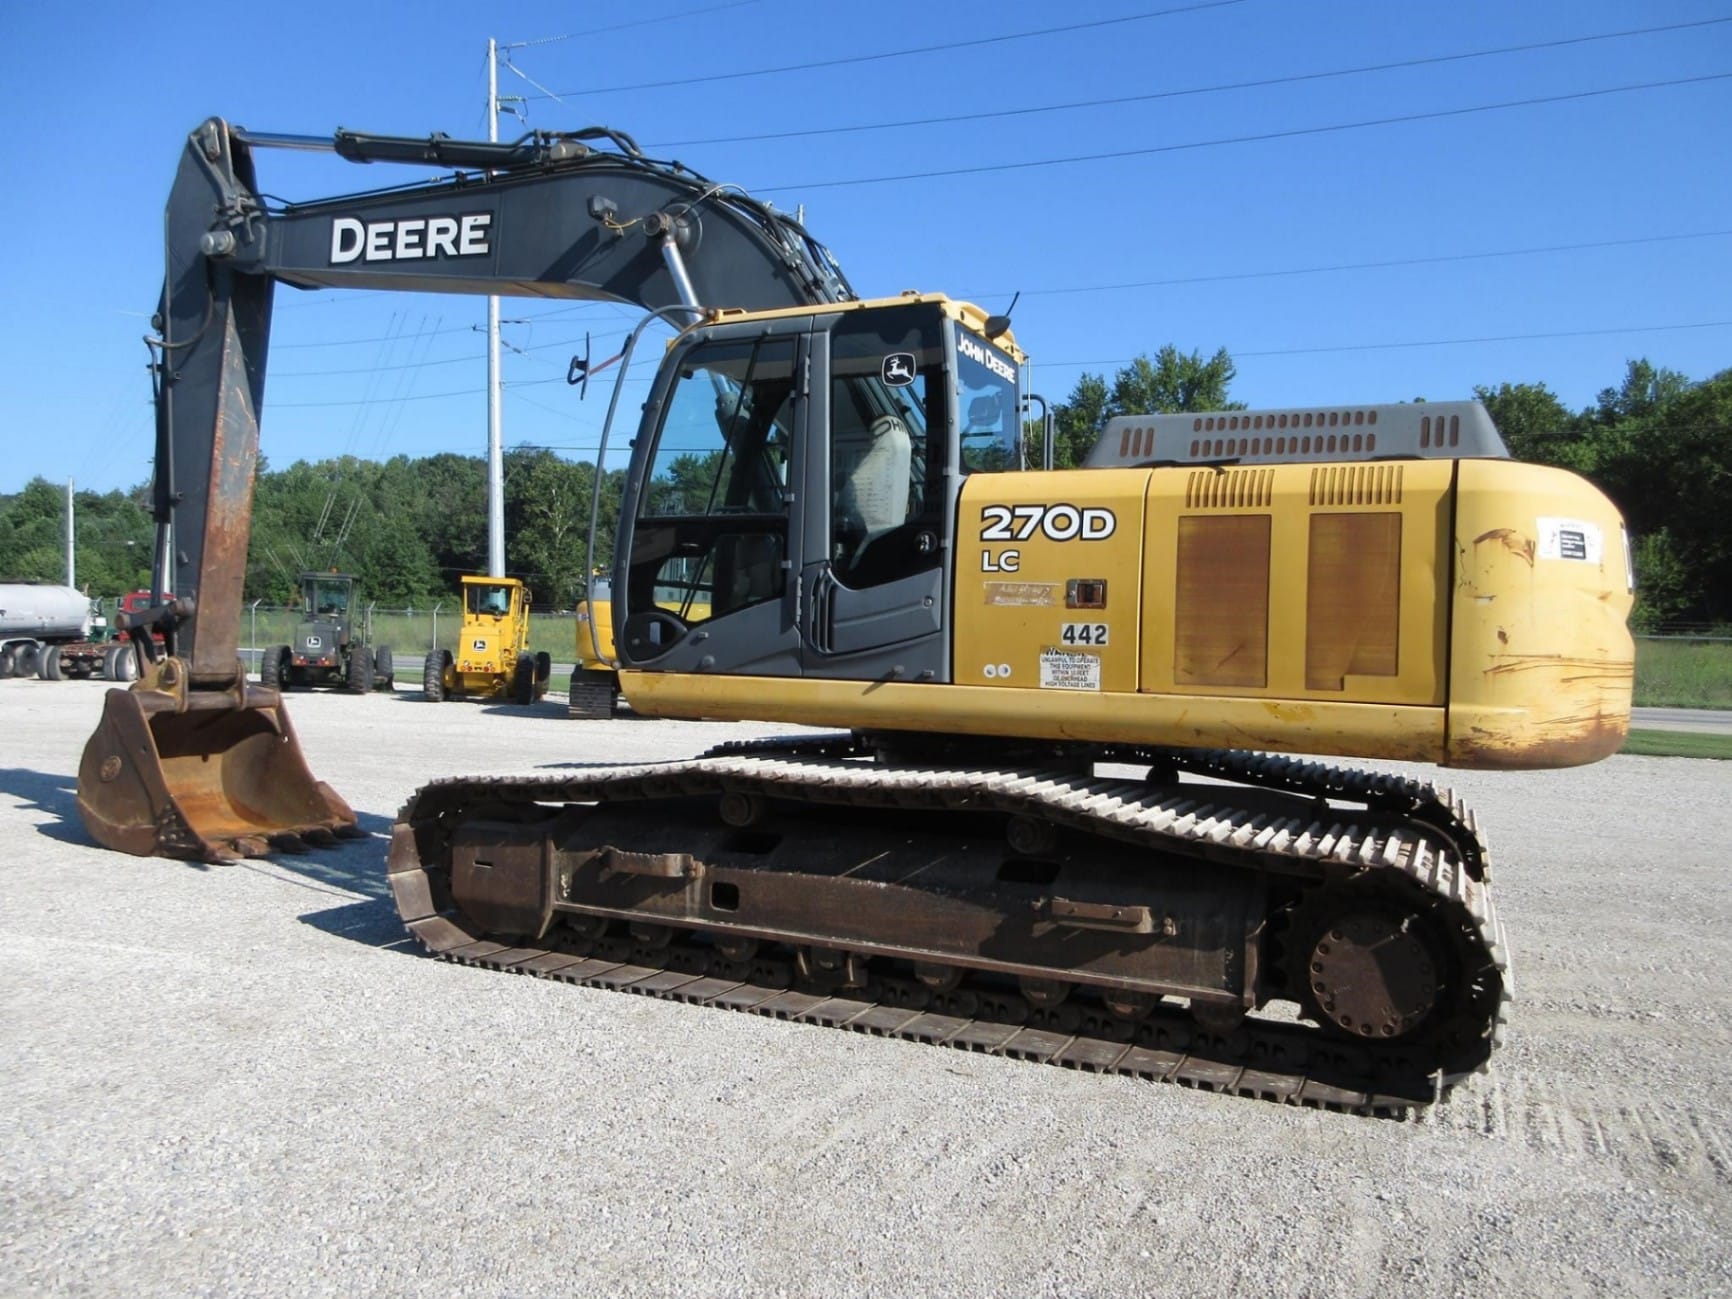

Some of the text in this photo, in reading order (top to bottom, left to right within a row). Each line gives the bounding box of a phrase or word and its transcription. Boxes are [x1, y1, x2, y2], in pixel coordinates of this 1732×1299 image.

[330, 213, 492, 264] DEERE
[957, 332, 1016, 385] JOHN DEERE
[980, 502, 1117, 542] 270D
[981, 550, 1021, 573] LC
[1062, 624, 1107, 645] 442
